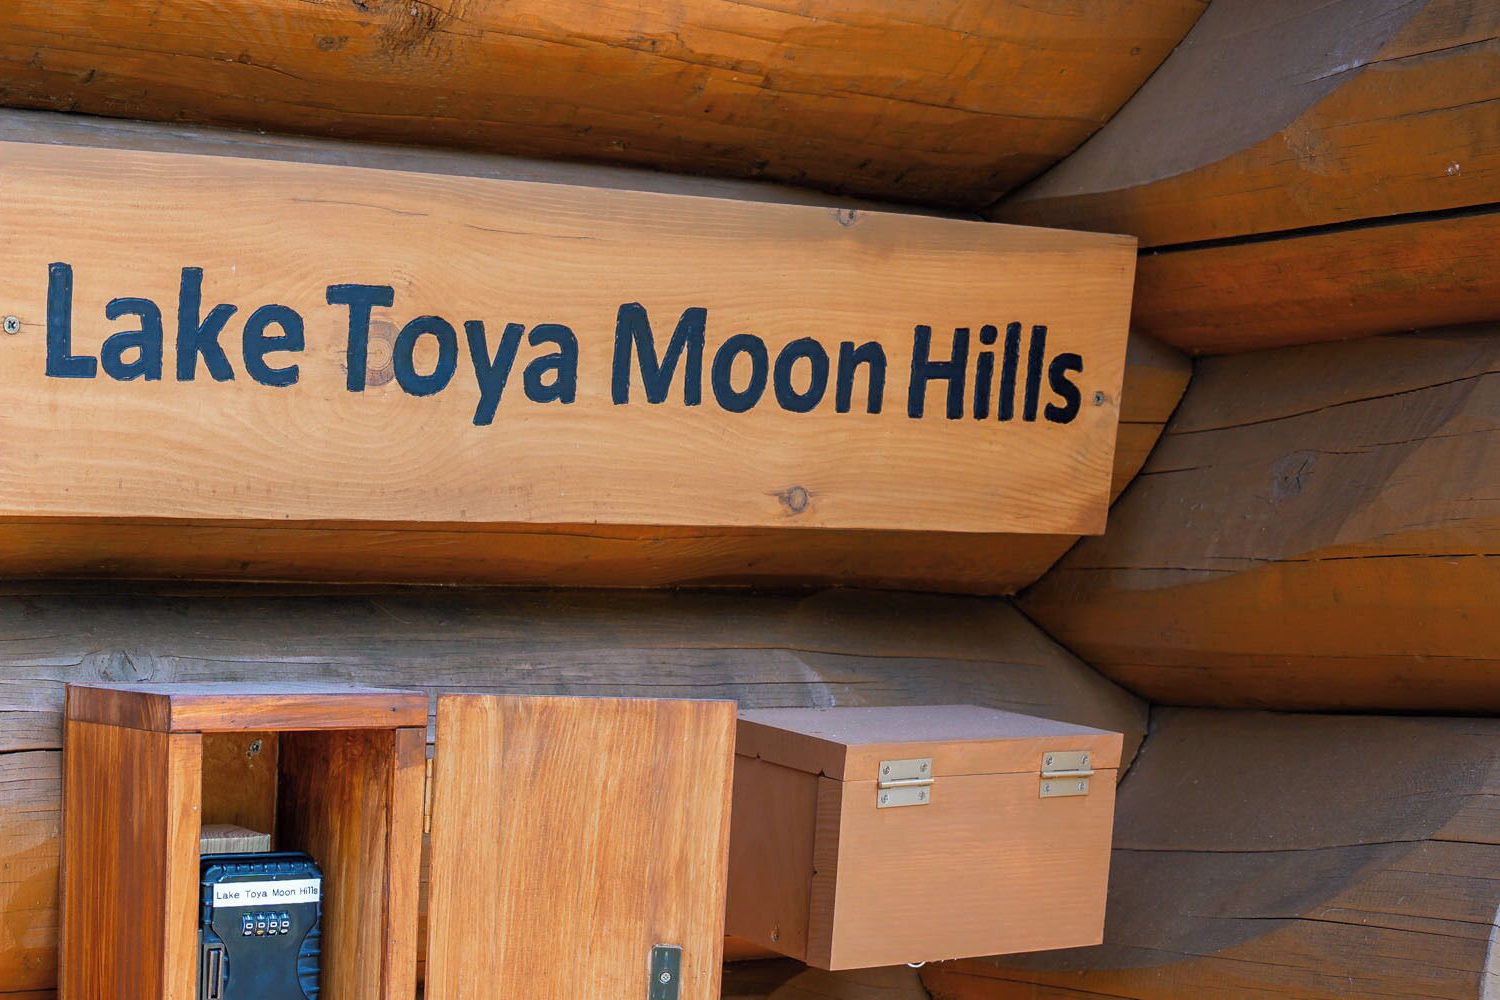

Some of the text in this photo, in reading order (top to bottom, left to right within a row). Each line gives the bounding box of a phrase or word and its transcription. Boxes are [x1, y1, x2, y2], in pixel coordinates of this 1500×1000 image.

[44, 261, 1084, 427] Lake Toya Moon Hills
[216, 886, 319, 900] Lake Toya Moon Hills
